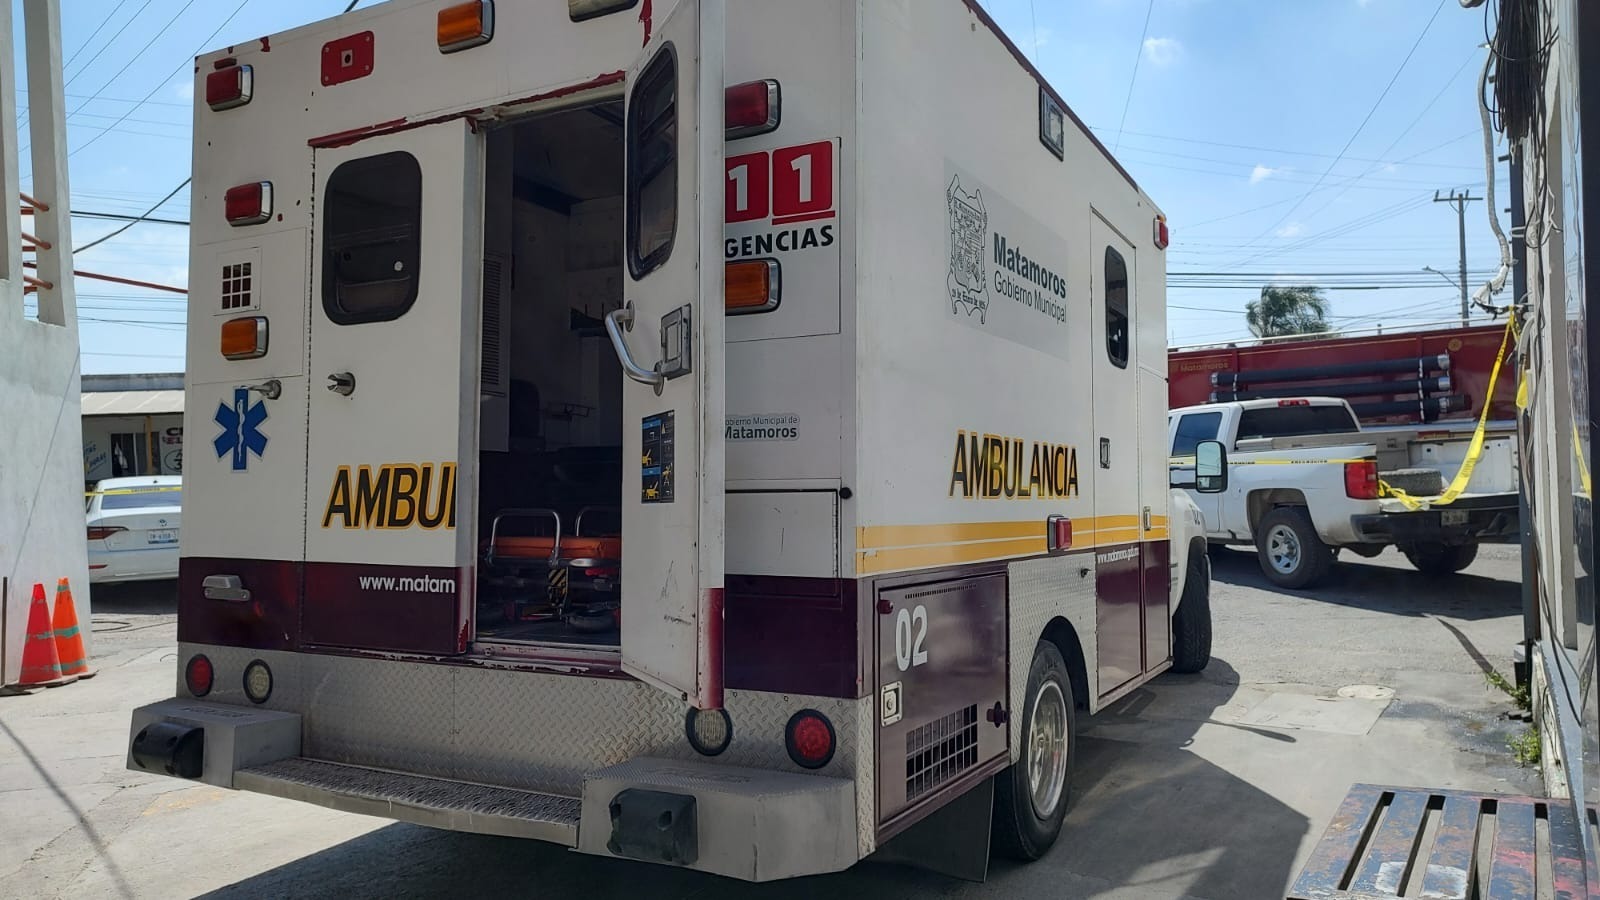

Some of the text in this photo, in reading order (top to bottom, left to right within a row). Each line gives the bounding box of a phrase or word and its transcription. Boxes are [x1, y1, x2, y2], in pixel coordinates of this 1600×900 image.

[725, 225, 833, 258] GENCIAS
[994, 232, 1066, 299] Matamoros
[995, 270, 1067, 325] Gobierno Municipal
[753, 416, 787, 426] Municipal
[789, 415, 798, 424] de
[949, 429, 1079, 499] AMBULANCIA
[359, 574, 455, 594] www.matam
[895, 604, 928, 672] 02
